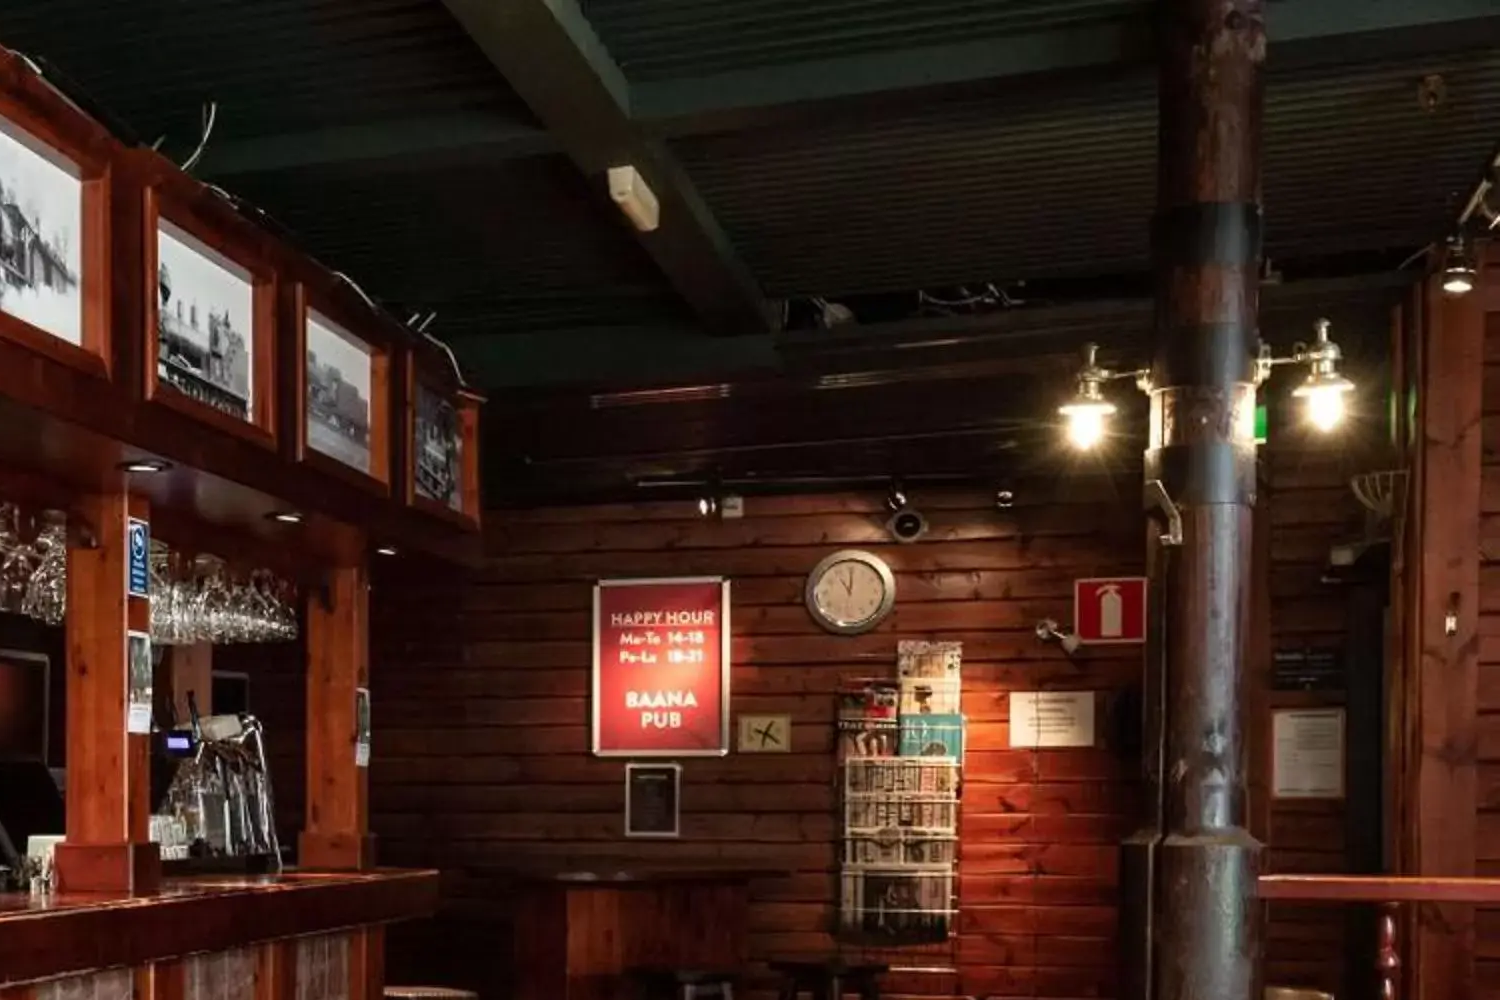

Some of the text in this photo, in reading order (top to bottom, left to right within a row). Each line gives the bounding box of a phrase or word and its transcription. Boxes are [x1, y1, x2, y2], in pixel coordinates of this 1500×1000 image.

[611, 610, 714, 627] HAPPY HOUR
[625, 690, 698, 708] BAANA
[641, 711, 682, 729] PUB
